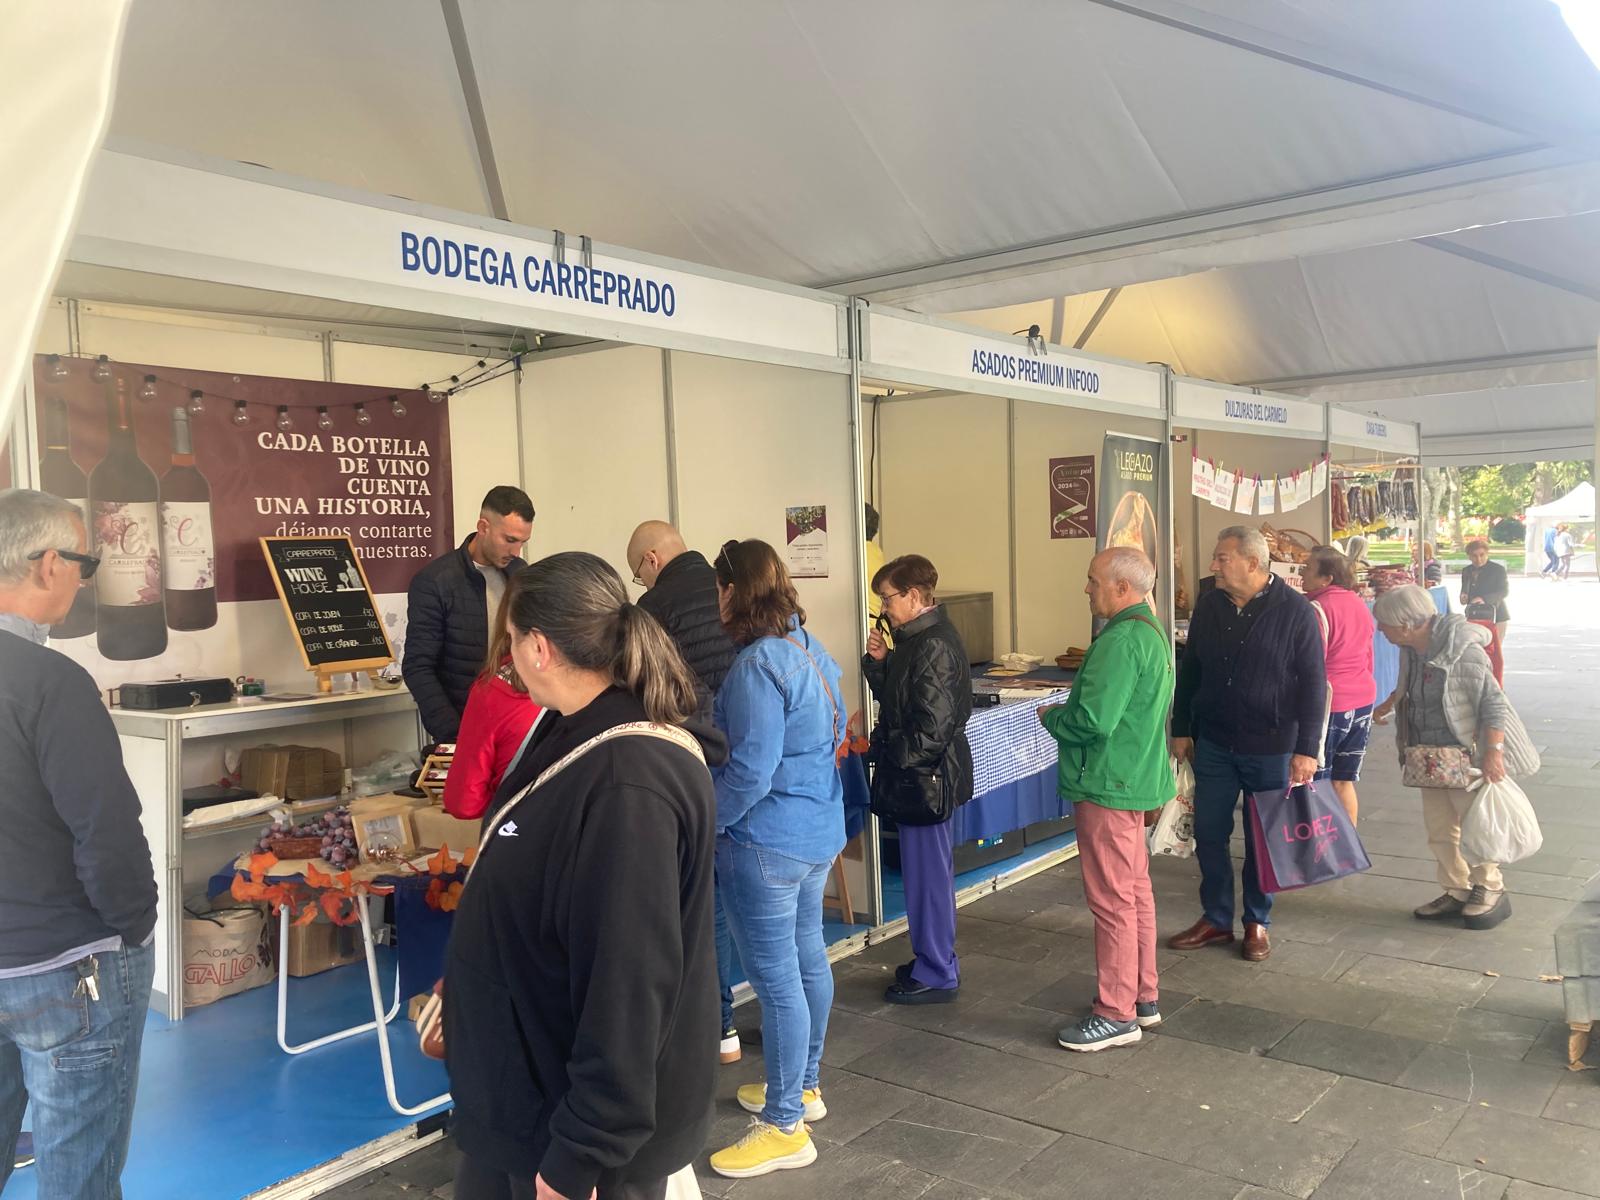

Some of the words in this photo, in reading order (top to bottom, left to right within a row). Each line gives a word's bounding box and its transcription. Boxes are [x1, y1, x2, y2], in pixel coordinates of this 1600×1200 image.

[401, 231, 518, 289] BODEGA
[523, 255, 676, 317] CARREPRADO
[972, 349, 1016, 380] ASADOS
[1018, 358, 1064, 388] PREMIUM
[1066, 368, 1099, 393] INFOOD
[1225, 400, 1253, 420] DULZURAS
[1254, 404, 1264, 421] DEL
[1264, 406, 1288, 424] CARMELO
[257, 431, 324, 452] CADA
[331, 435, 430, 457] BOTELLA
[338, 457, 369, 474] DE
[376, 458, 430, 476] VINO
[347, 478, 431, 496] CUENTA
[254, 497, 309, 515] UNA
[317, 498, 431, 519] HISTORIA,
[359, 525, 432, 539] contarte
[286, 549, 335, 558] CARREPRADO
[284, 567, 327, 582] WINE
[290, 582, 334, 594] HOUSE
[313, 611, 322, 619] DE
[319, 625, 328, 634] DE
[325, 640, 334, 649] DE
[192, 949, 247, 958] MODA
[184, 954, 256, 985] GALLO
